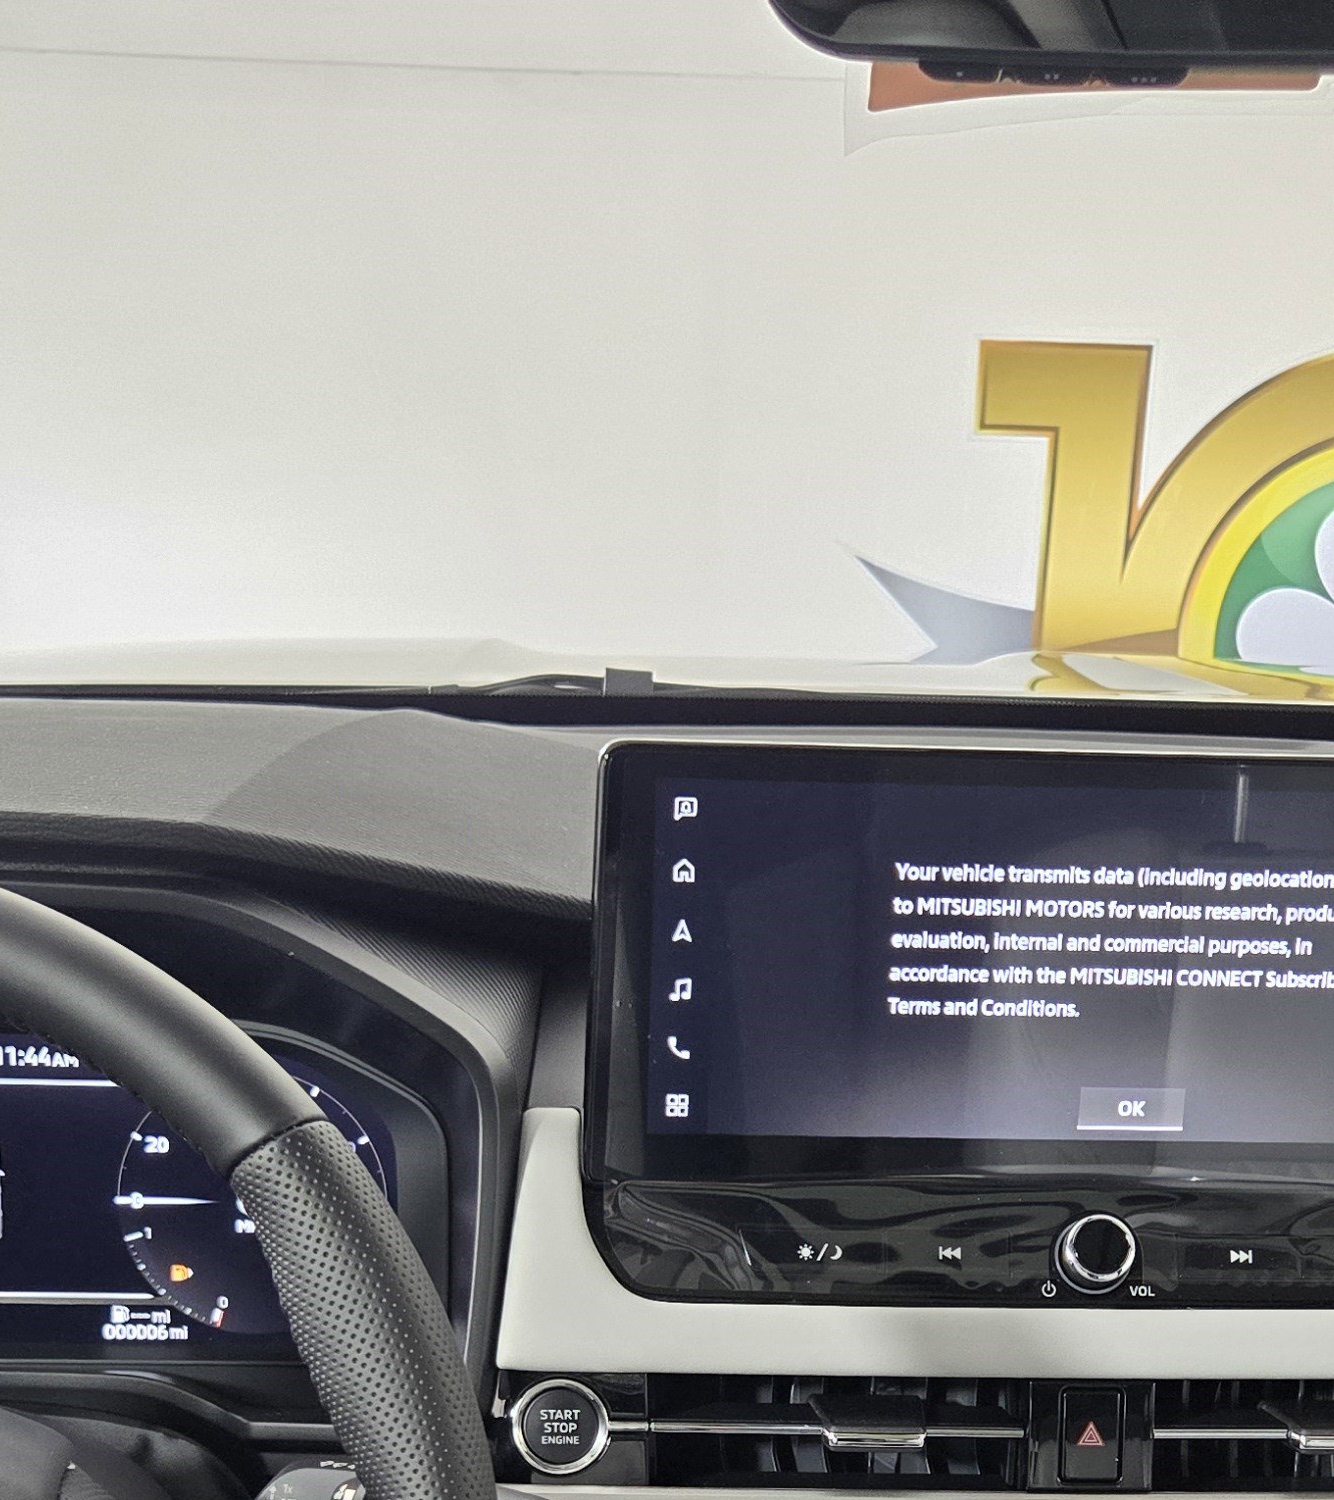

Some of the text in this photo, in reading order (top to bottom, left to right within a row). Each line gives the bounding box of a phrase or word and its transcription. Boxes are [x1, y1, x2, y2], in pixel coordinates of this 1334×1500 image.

[894, 862, 940, 882] Your
[942, 864, 1005, 883] vehicle
[1009, 865, 1090, 884] transmits
[1093, 867, 1134, 885] data
[1138, 867, 1226, 890] (including
[1230, 870, 1334, 891] geolocation
[892, 897, 913, 915] to
[917, 897, 1021, 917] MITSUBISHI
[1026, 900, 1105, 918] MOTORS
[1108, 900, 1136, 919] for
[1138, 901, 1202, 920] various
[1204, 903, 1282, 925] research,
[891, 931, 1313, 958] evaluation, internal and commercial purposes, in
[888, 964, 990, 983] accordance
[993, 966, 1033, 984] with
[1036, 966, 1067, 984] the
[1070, 967, 1172, 986] MITSUBISHI
[1176, 969, 1264, 988] CONNECT
[887, 997, 1080, 1018] Terms and Conditions.
[1117, 1100, 1146, 1118] OK
[144, 1136, 170, 1154] 20
[144, 1227, 152, 1239] 1
[1129, 1285, 1156, 1298] VOL
[218, 1296, 229, 1309] 0
[540, 1409, 581, 1420] START
[544, 1422, 577, 1433] STOP
[541, 1436, 580, 1445] ENGINE
